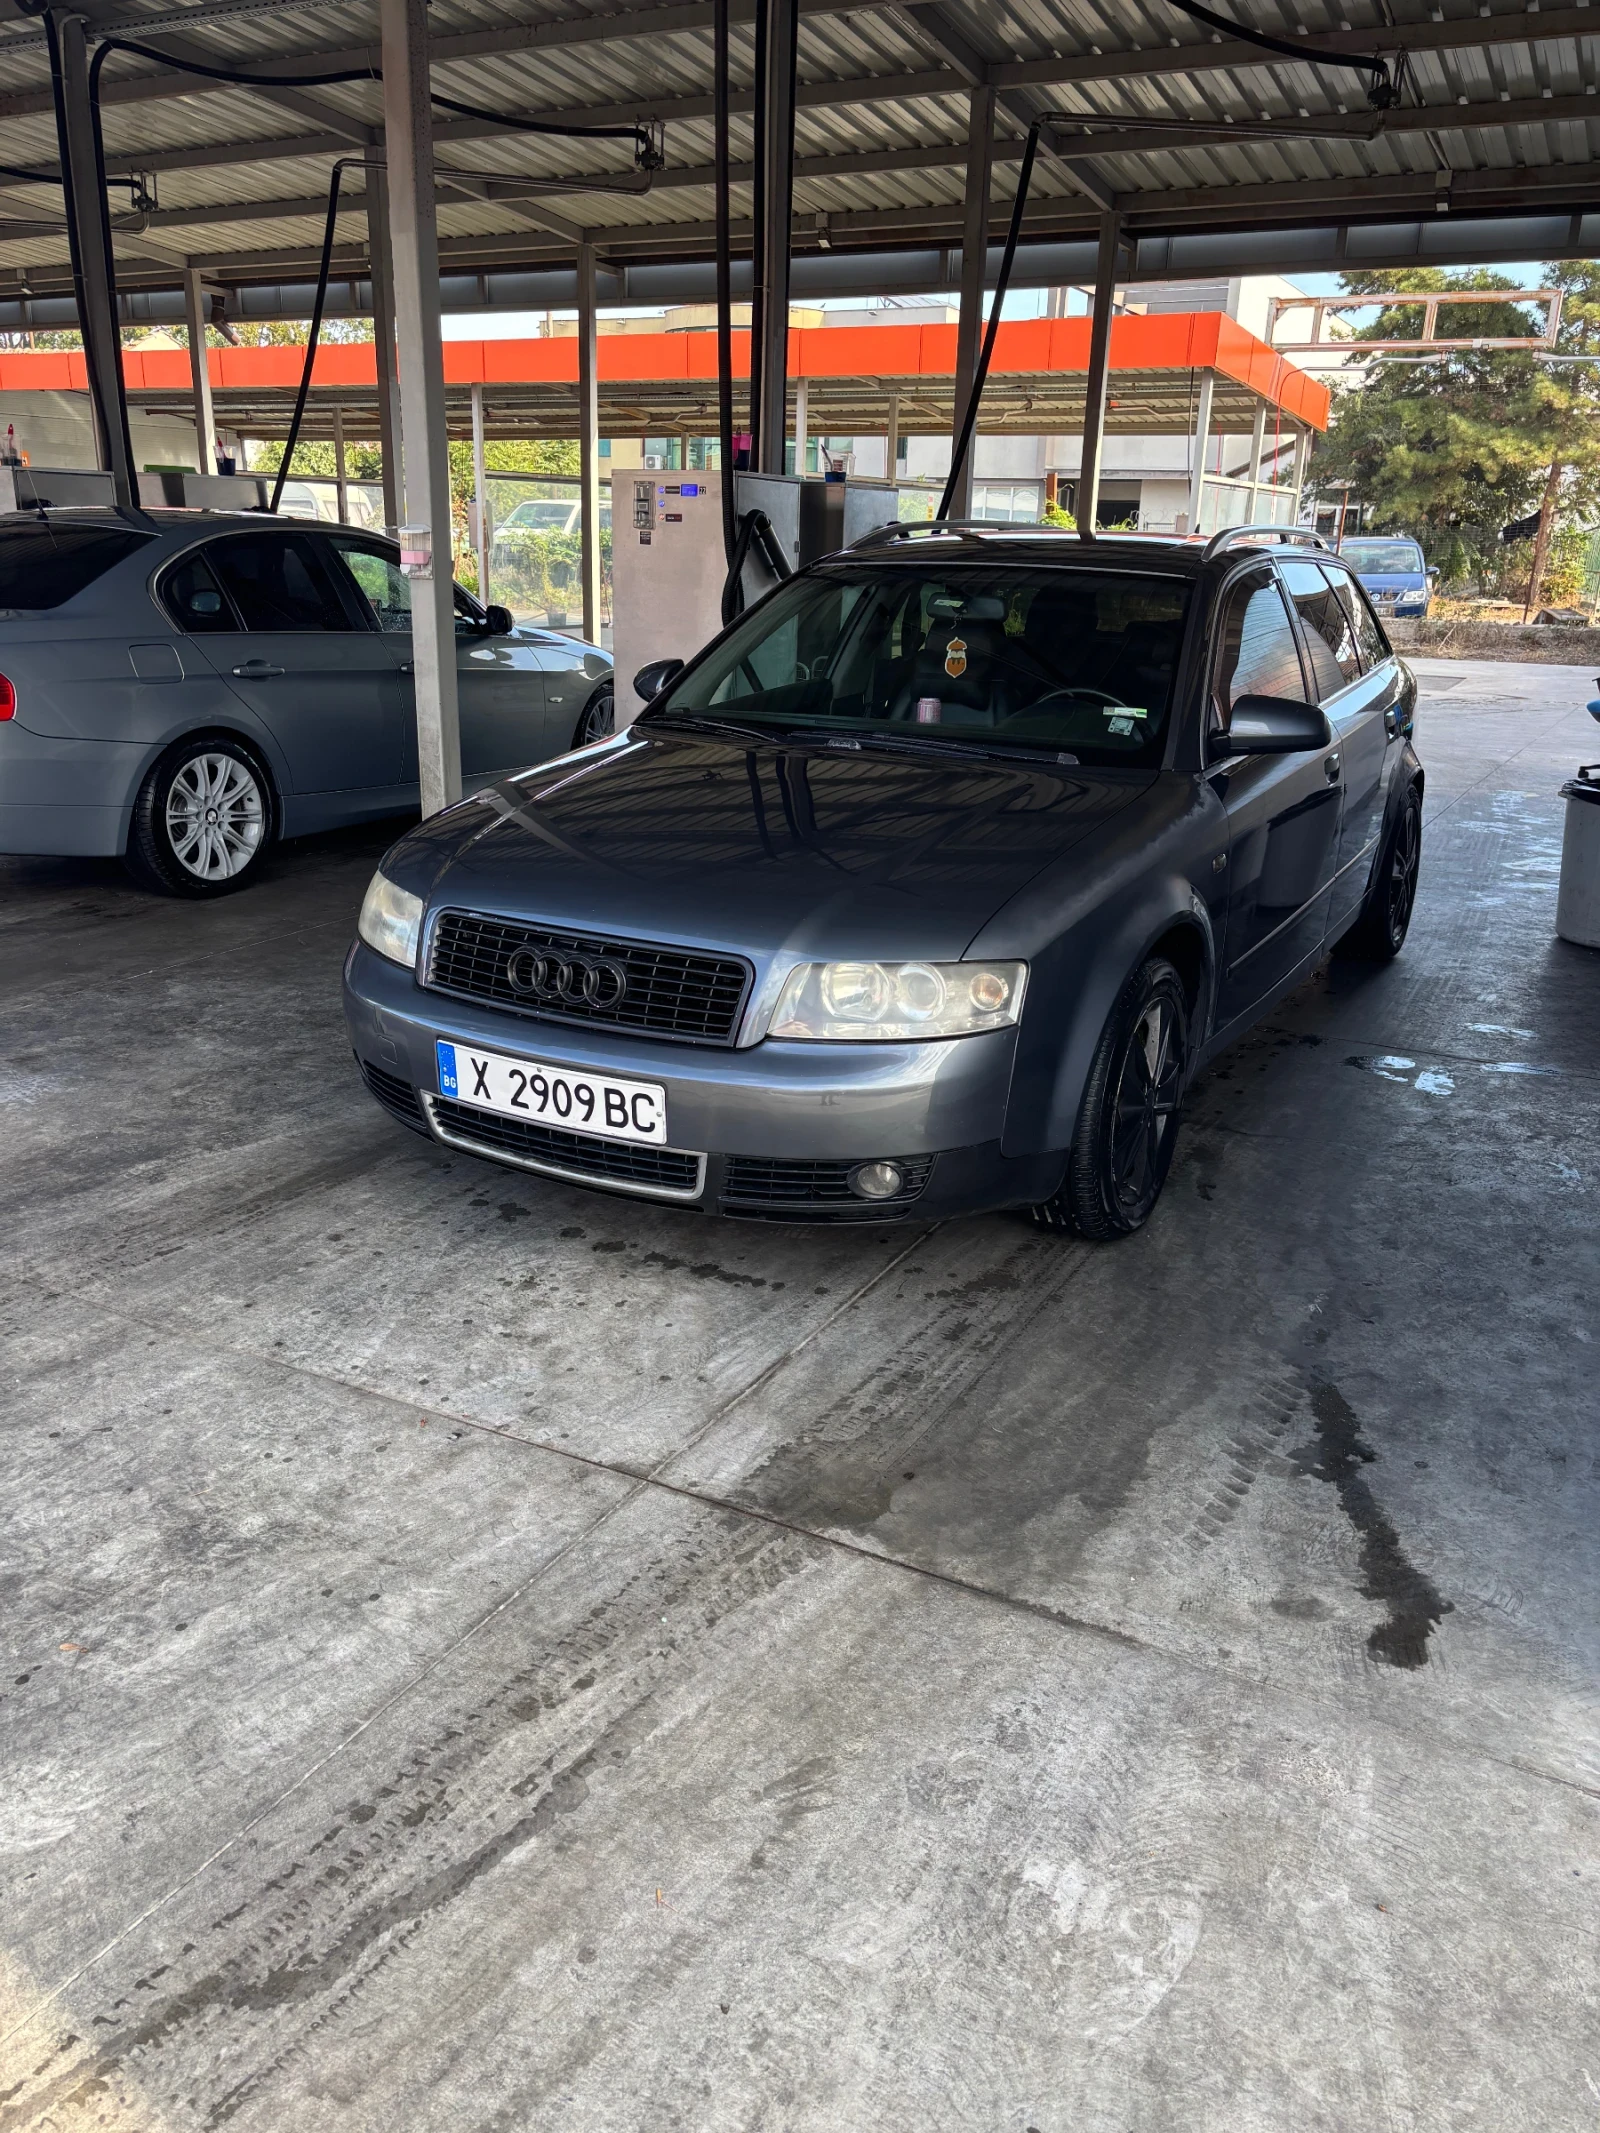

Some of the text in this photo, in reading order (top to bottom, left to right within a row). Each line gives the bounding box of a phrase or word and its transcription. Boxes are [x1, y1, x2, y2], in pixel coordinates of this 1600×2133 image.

[443, 1074, 457, 1089] BG
[470, 1057, 656, 1133] X 2909 BC
